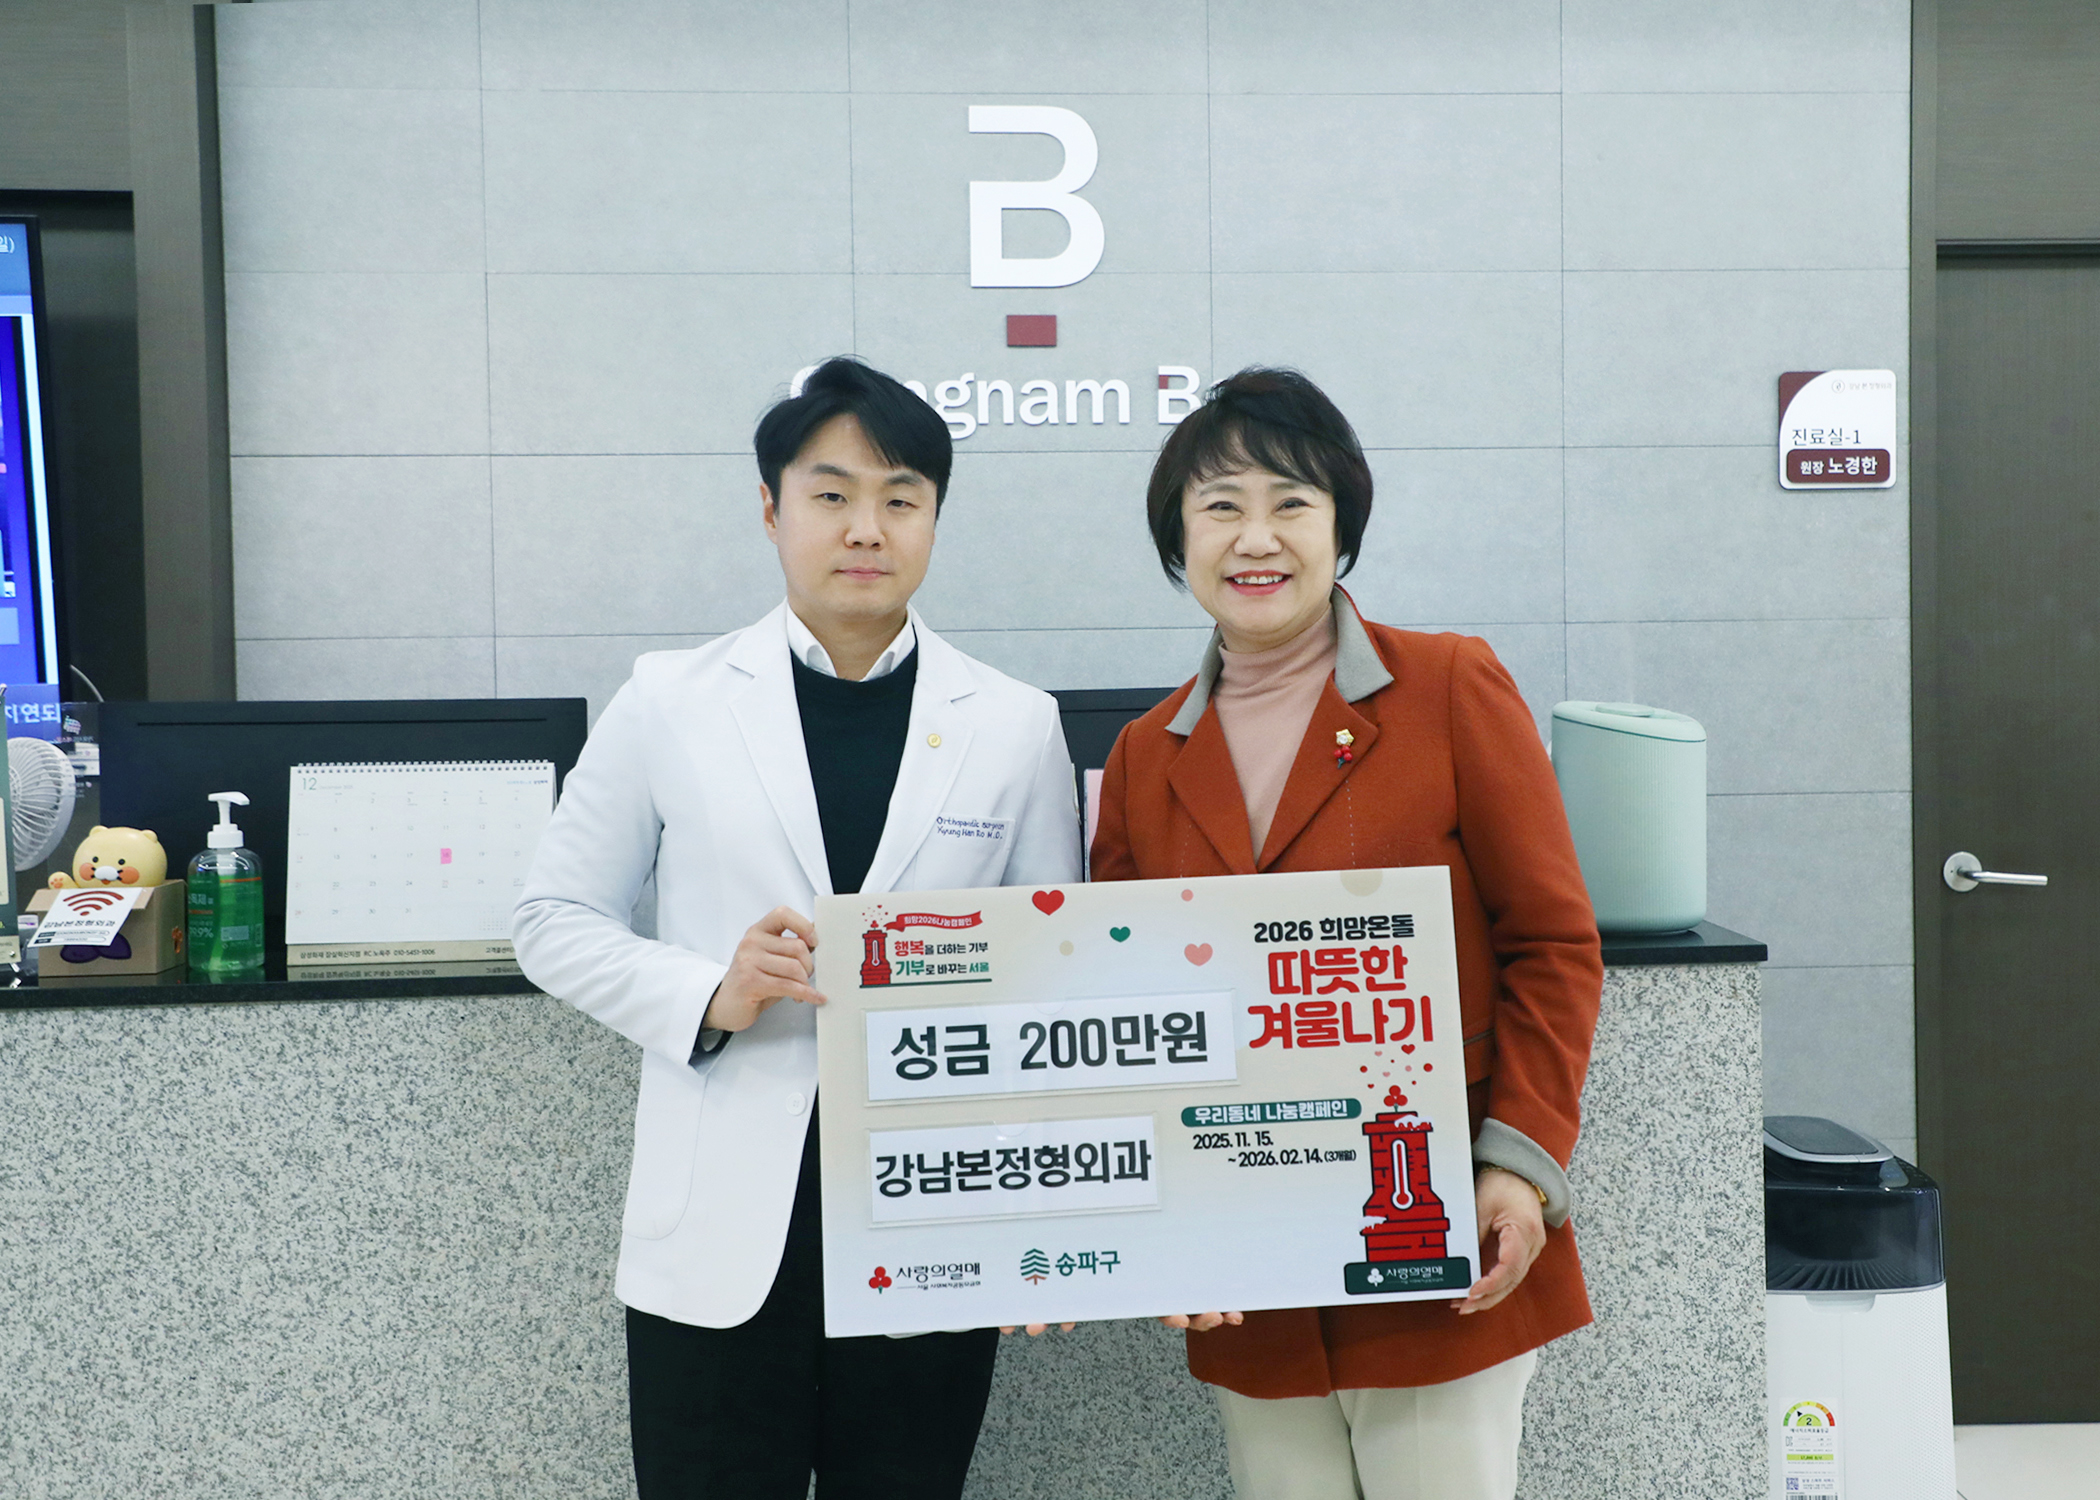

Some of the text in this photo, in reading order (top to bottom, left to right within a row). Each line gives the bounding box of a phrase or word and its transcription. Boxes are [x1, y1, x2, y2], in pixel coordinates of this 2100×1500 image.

[1792, 427, 1862, 446] 진료실-1
[1800, 456, 1878, 476] 원장 노경한
[302, 777, 318, 791] 12
[904, 915, 973, 927] 희망2026나눔캠페인
[1253, 914, 1415, 943] 2026 희망온돌
[894, 940, 989, 957] 행복을 더하는 기부
[895, 960, 990, 976] 기부로 바꾸는 서울
[1268, 944, 1408, 995] 따뜻한
[1248, 995, 1433, 1049] 겨울나기
[891, 1011, 1209, 1081] 성금 200만원
[1194, 1099, 1348, 1125] 우리동네 나눔캠페인
[875, 1139, 1152, 1198] 강남본정형외과
[896, 1262, 981, 1283] 사랑의열매
[1055, 1250, 1122, 1277] 송파구
[1386, 1265, 1444, 1279] 사랑의열매
[1805, 1417, 1813, 1426] 2
